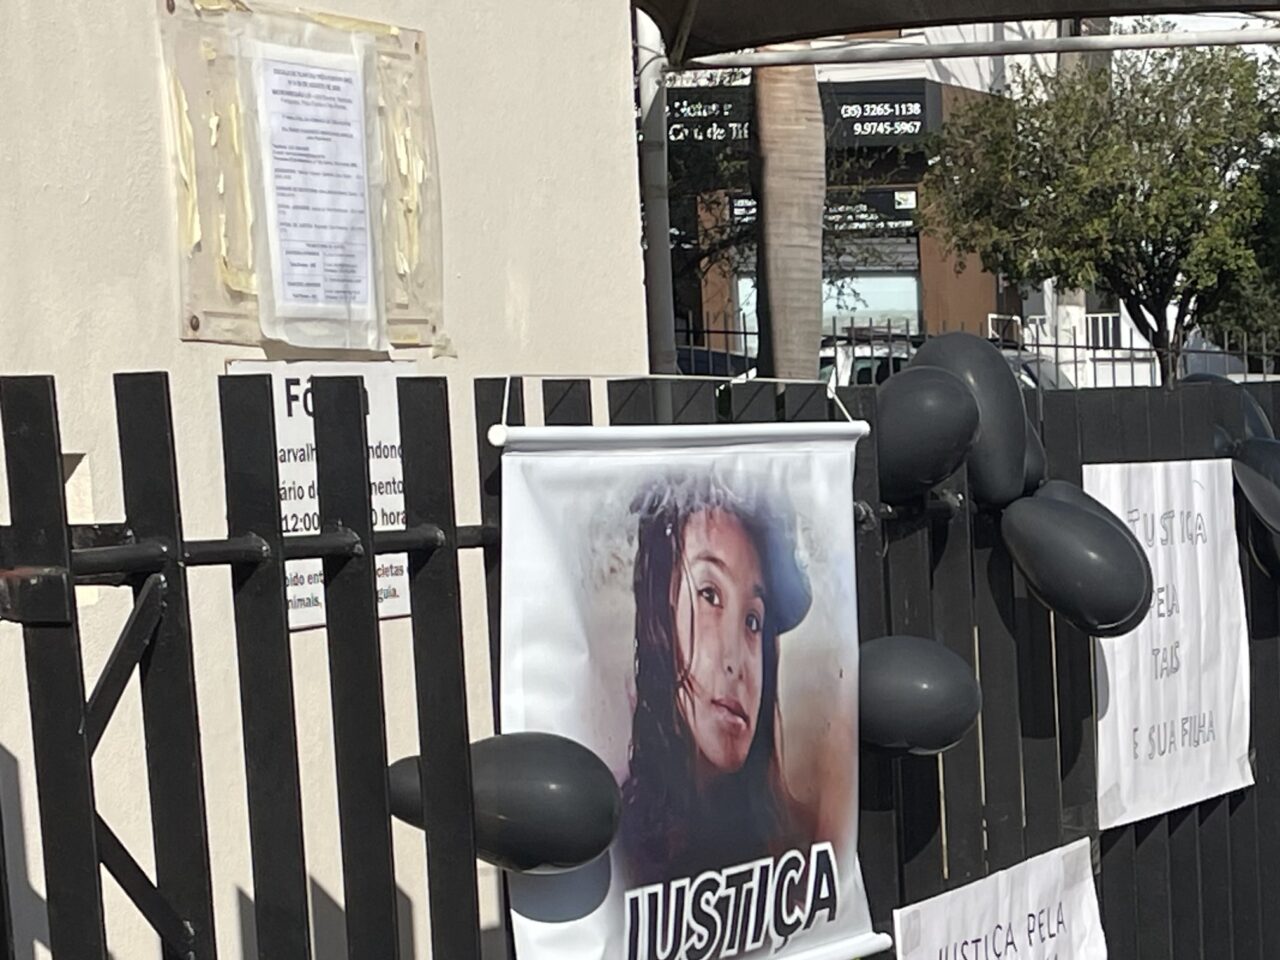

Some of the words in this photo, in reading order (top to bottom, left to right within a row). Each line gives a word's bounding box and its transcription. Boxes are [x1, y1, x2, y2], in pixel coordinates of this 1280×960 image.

[841, 104, 862, 118] (35)
[863, 103, 921, 116] 3265-1138
[853, 121, 921, 135] 9.9745-5967
[1148, 720, 1177, 760] SUA
[1027, 901, 1067, 947] PELA
